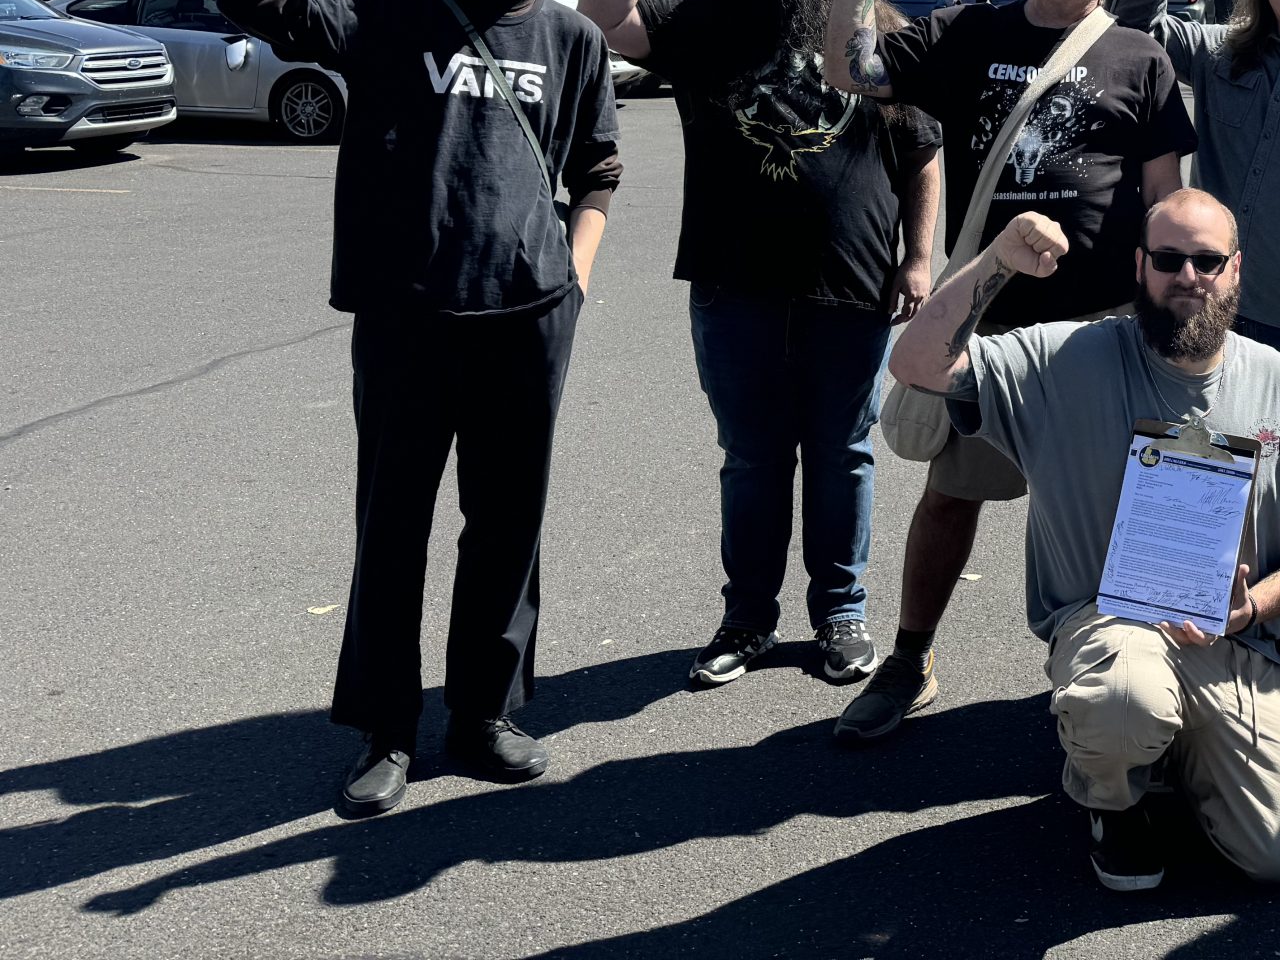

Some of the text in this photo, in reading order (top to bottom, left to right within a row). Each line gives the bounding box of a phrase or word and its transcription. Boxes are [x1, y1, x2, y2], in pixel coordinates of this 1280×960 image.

[423, 52, 547, 103] VANS
[992, 191, 1037, 200] ssassination
[1039, 191, 1047, 200] of
[1049, 191, 1059, 199] an
